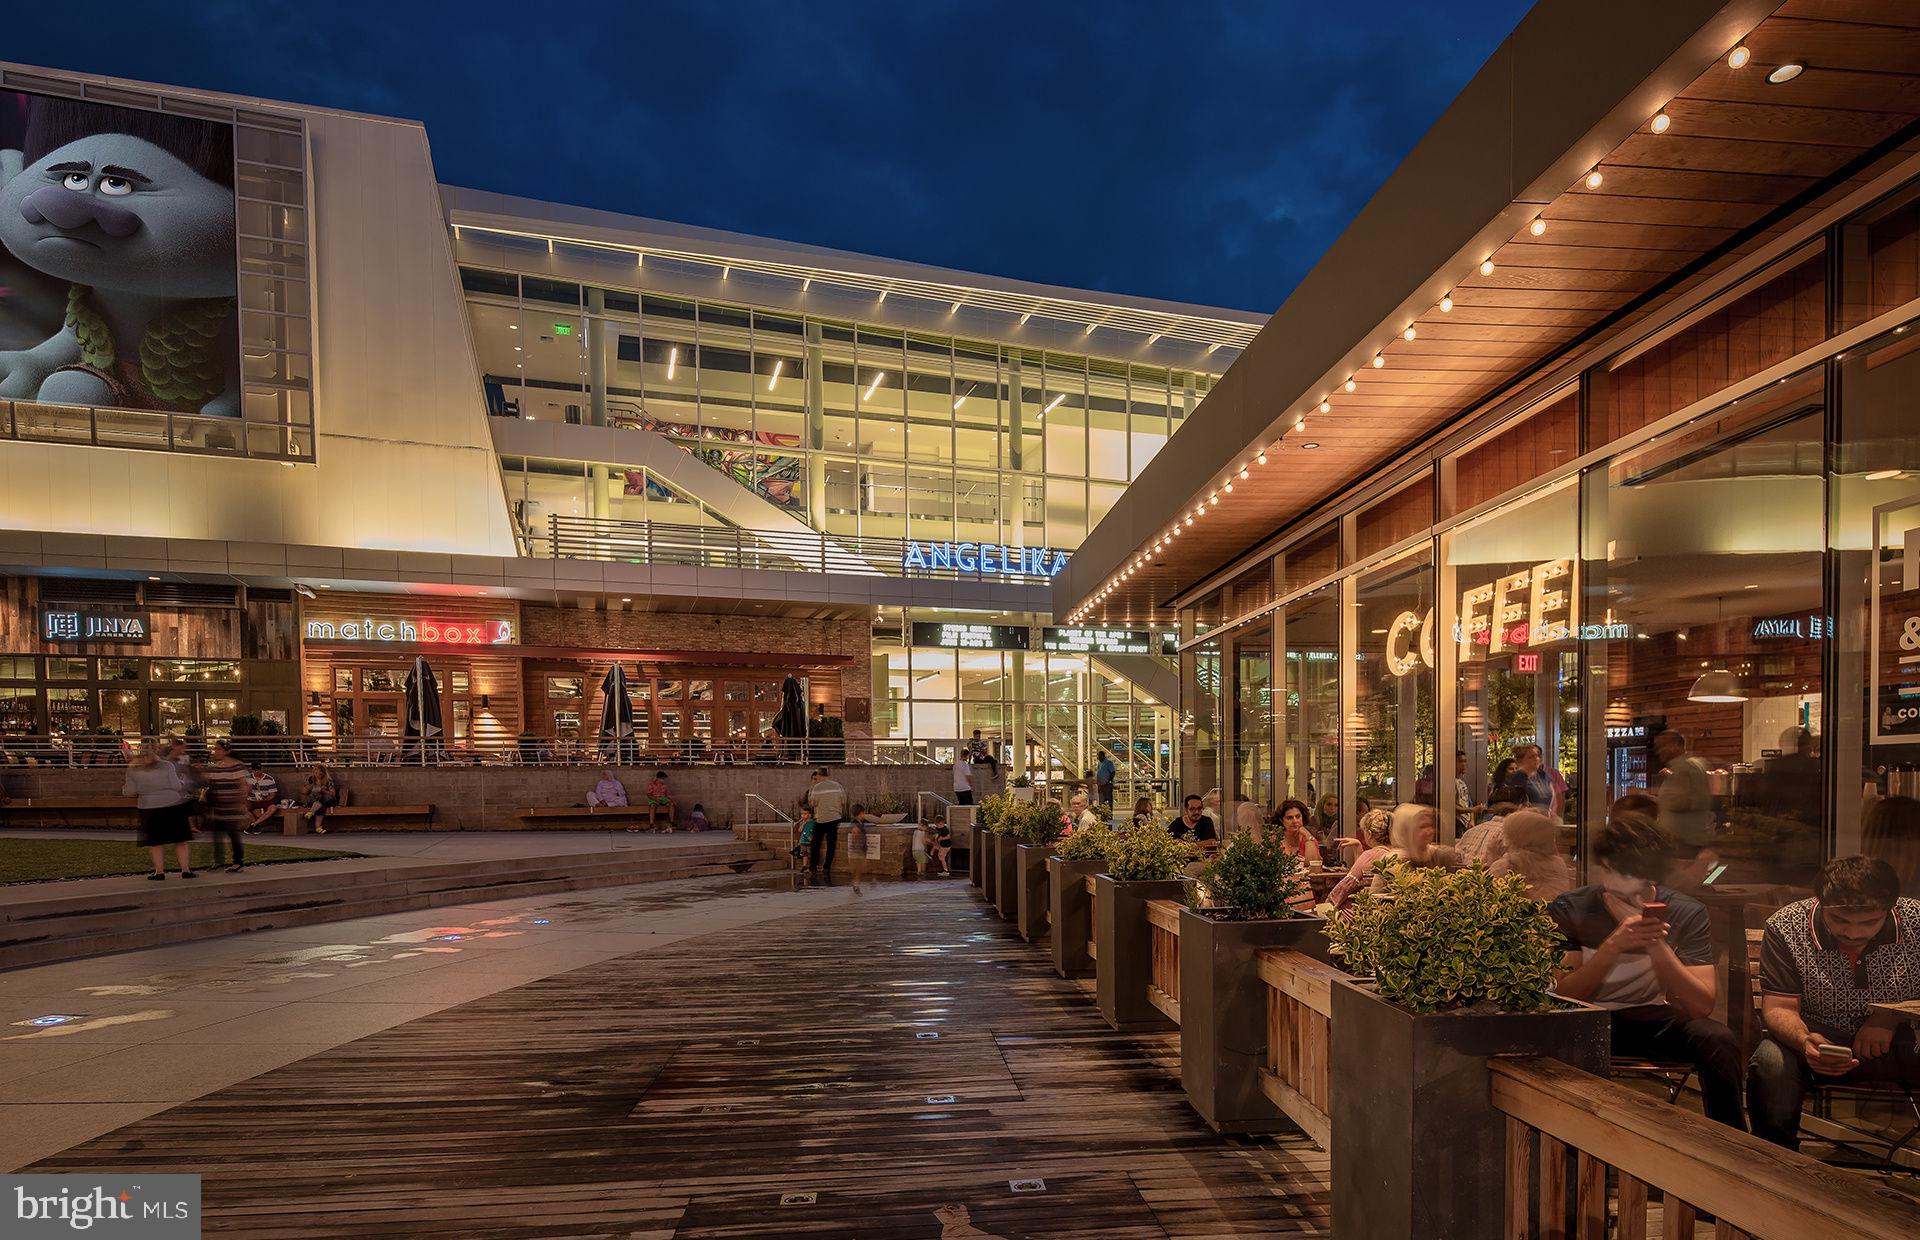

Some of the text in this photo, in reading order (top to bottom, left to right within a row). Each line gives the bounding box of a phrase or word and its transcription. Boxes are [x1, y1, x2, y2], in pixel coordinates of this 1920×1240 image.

[904, 541, 1069, 576] ANGELIKA
[1386, 553, 1579, 676] CFFE
[86, 617, 144, 637] JINYA
[308, 620, 481, 643] matchbox
[1518, 654, 1538, 671] EXIT
[1898, 708, 1920, 719] CO
[1607, 727, 1634, 738] EZZA
